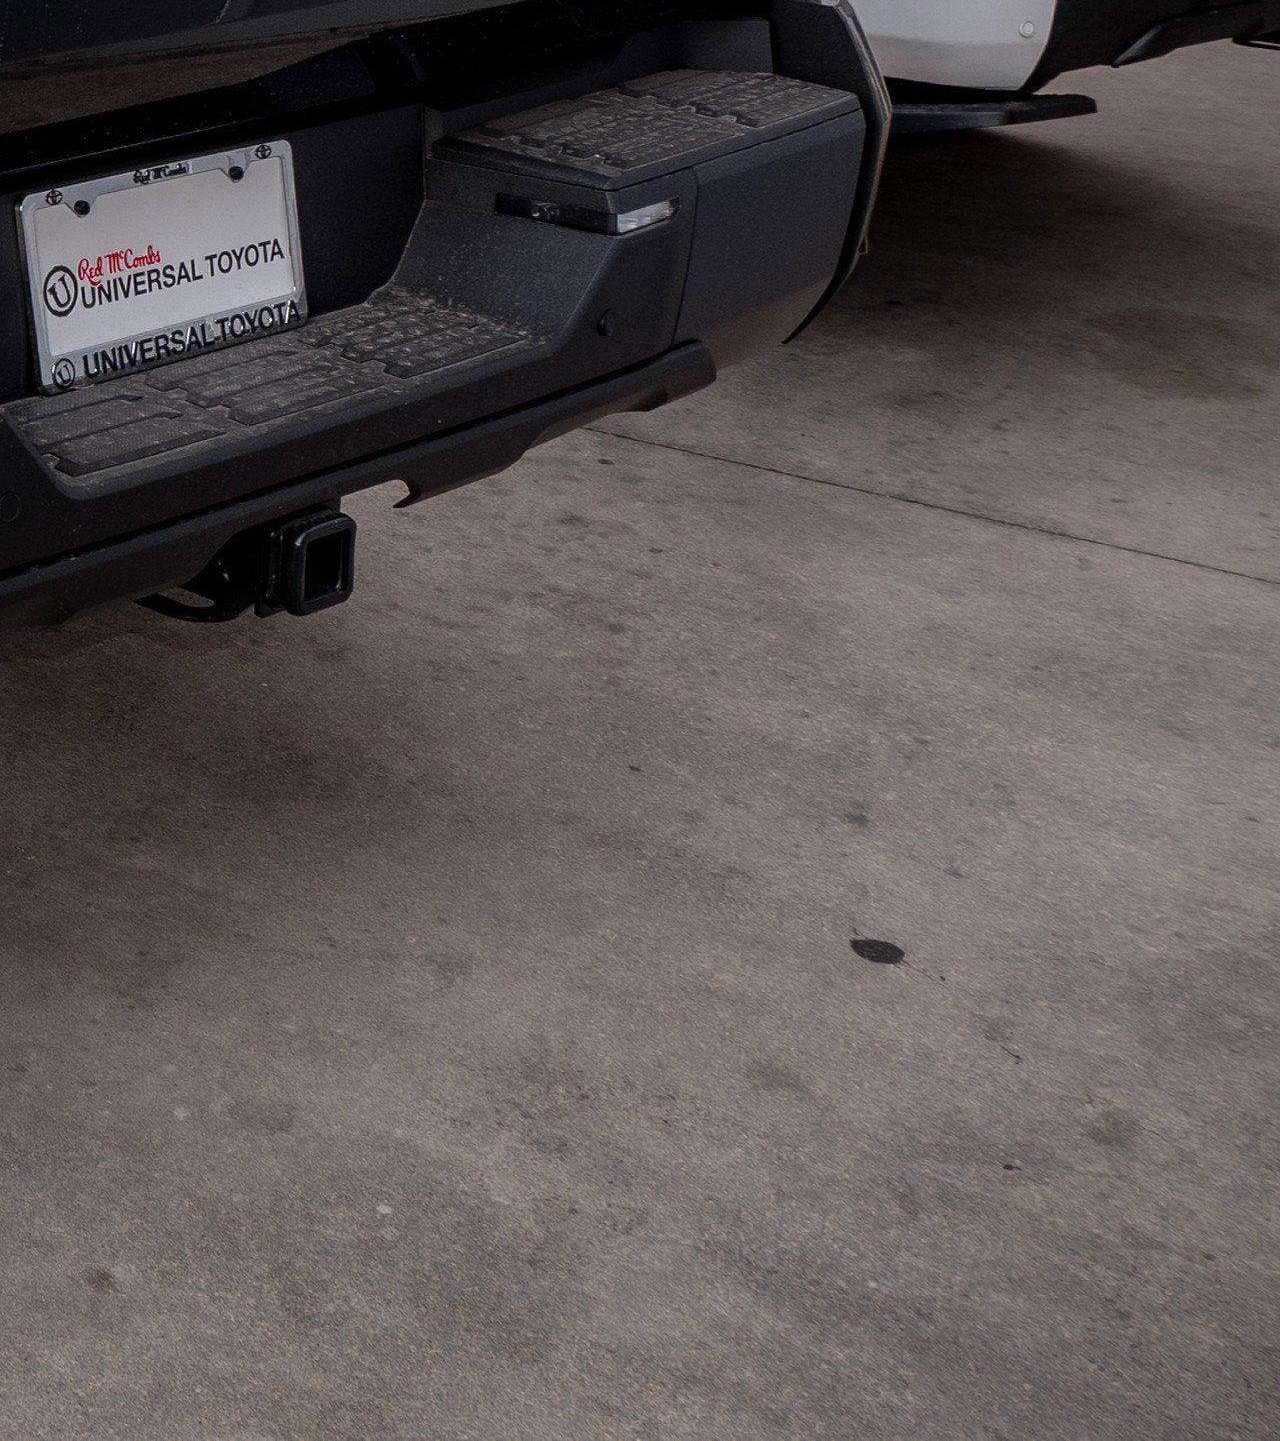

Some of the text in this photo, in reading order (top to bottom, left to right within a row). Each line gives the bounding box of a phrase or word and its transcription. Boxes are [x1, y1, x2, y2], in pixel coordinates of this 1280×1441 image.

[78, 244, 161, 287] Red McCombs
[80, 238, 285, 309] UNIVERSAL TOYOTA
[83, 299, 301, 380] UNIVERSAL TOYOTA
